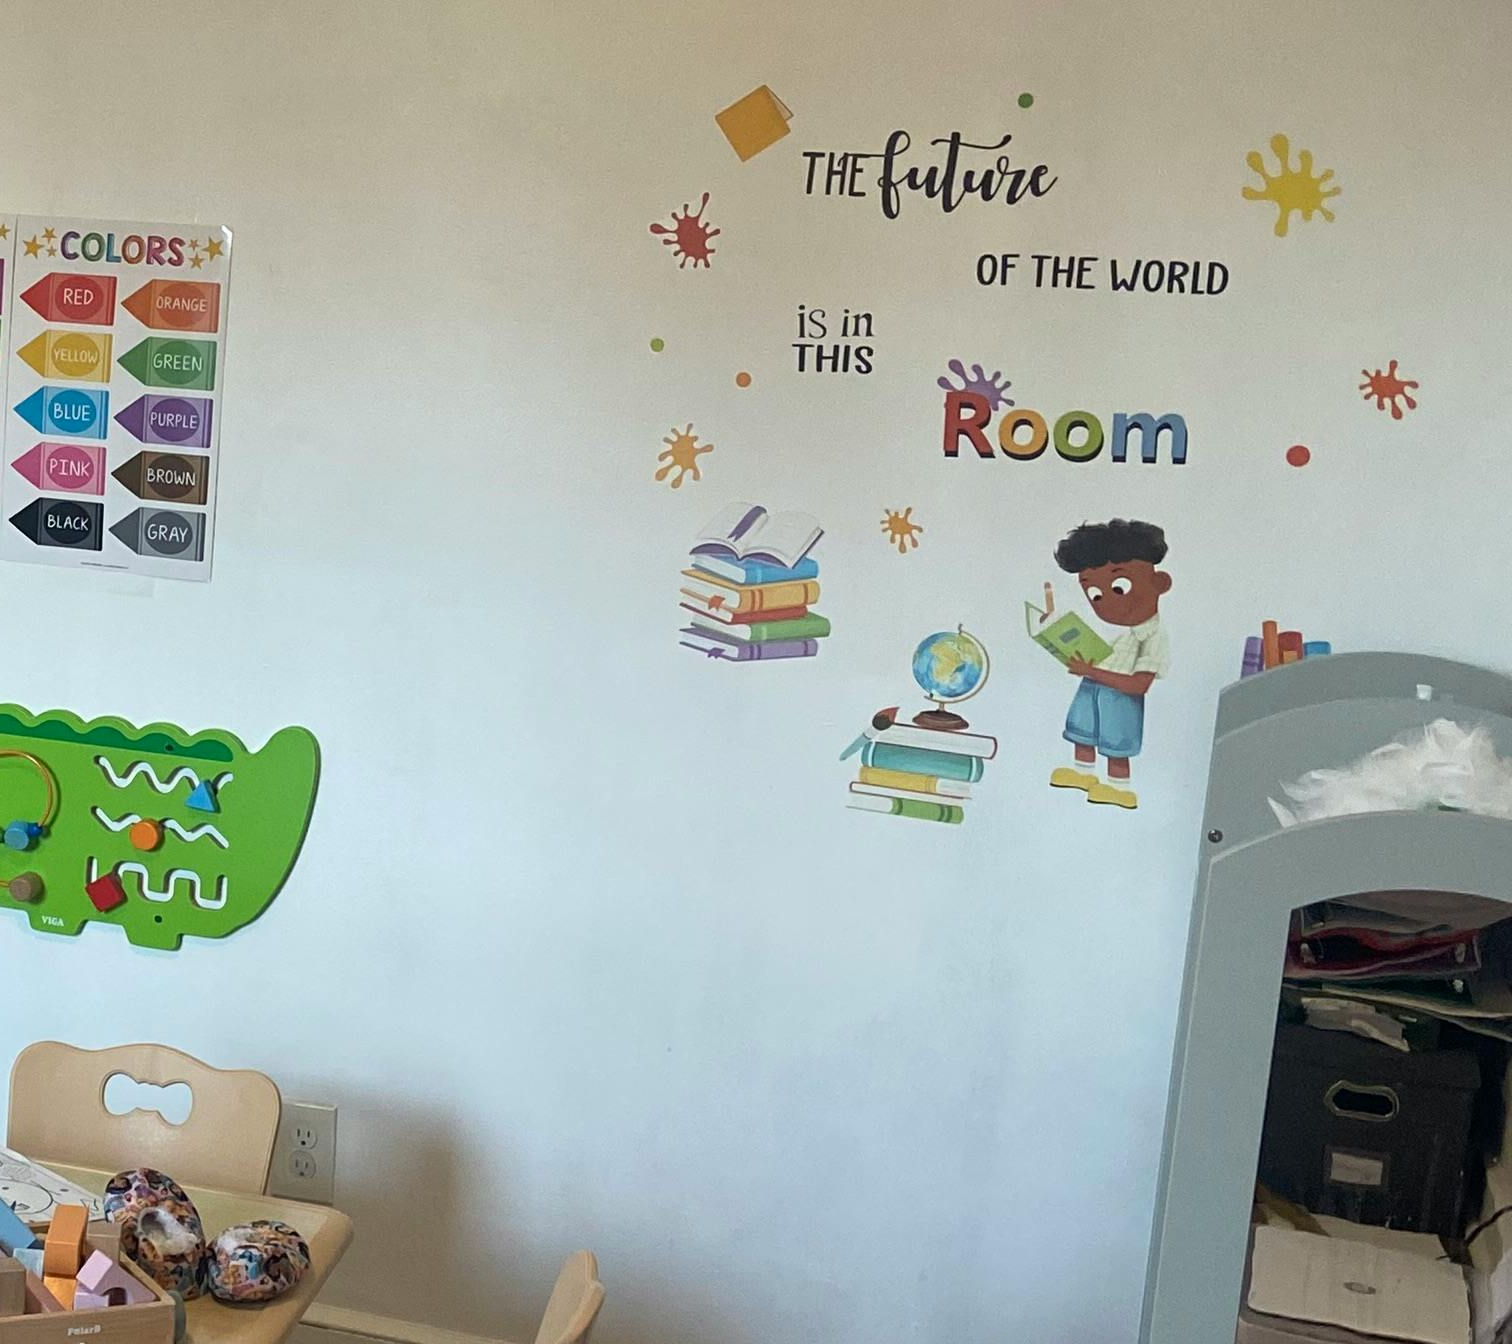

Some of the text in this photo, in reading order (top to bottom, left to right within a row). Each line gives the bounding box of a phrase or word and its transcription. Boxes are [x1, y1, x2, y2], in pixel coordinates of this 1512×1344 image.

[802, 130, 1058, 220] THE future
[60, 231, 186, 267] COLORS
[975, 254, 1229, 296] OF THE WORLD
[63, 288, 94, 305] RED
[156, 296, 208, 312] ORANGE
[840, 309, 874, 338] in
[54, 348, 98, 364] YELLOW
[153, 354, 202, 372] GREEN
[792, 344, 874, 375] THIS
[53, 402, 91, 422] BLUE
[150, 412, 198, 430] PURPLE
[942, 391, 1188, 465] Room
[49, 458, 91, 477] PINK
[147, 468, 196, 486] BROWN
[47, 514, 89, 531] BLACK
[147, 524, 188, 543] GRAY
[42, 915, 65, 926] VIGA
